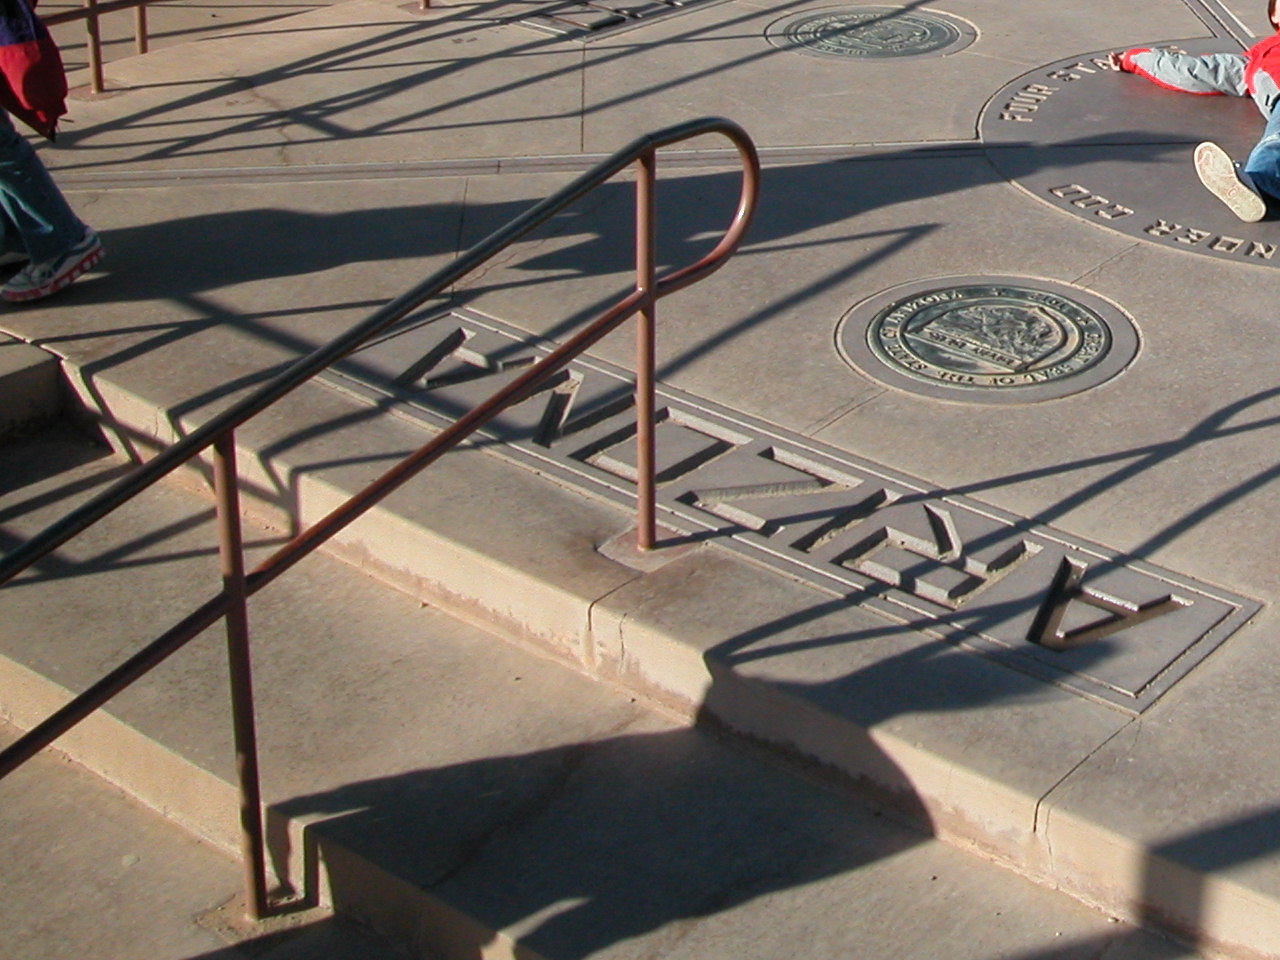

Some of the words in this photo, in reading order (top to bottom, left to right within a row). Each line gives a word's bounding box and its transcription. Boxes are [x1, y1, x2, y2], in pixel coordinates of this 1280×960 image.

[1000, 83, 1060, 123] FOUR
[1049, 183, 1135, 220] GOD
[393, 326, 1194, 652] ARIZONA
